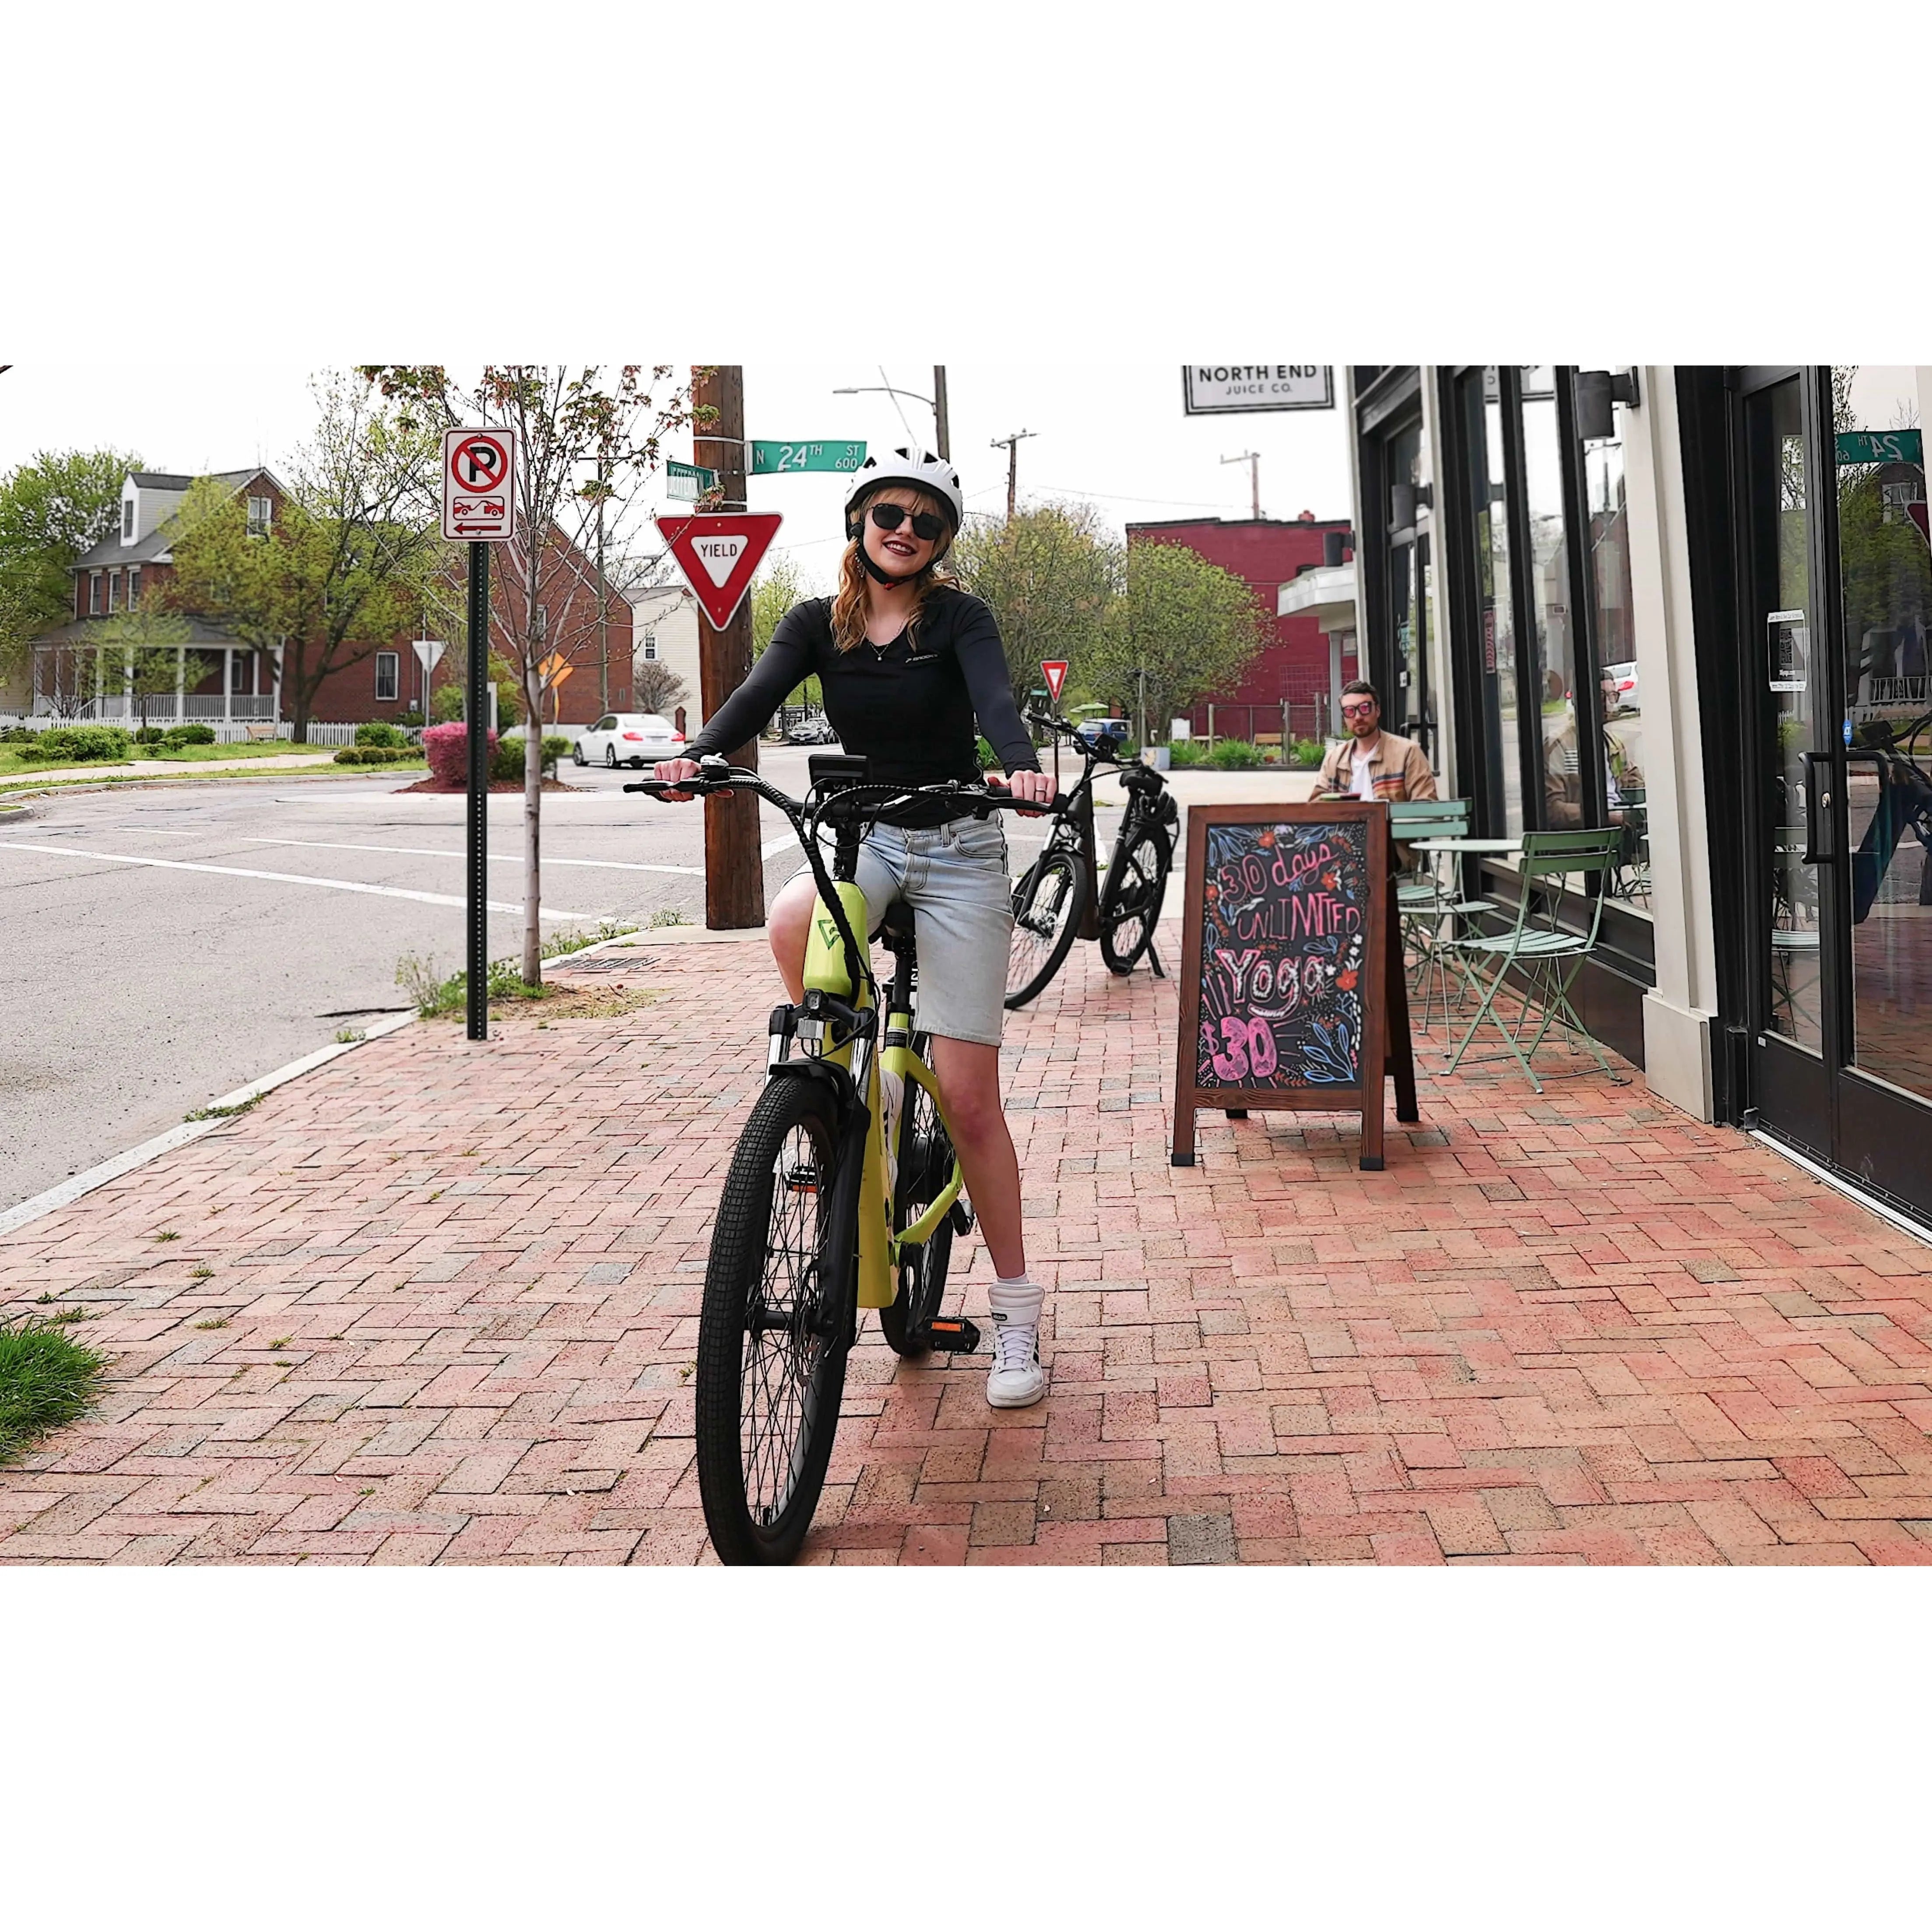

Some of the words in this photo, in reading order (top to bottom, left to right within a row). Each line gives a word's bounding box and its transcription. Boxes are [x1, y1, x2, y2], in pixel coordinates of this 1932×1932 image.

[1199, 365, 1268, 382] NORTH
[1277, 365, 1317, 379] END
[1226, 384, 1264, 395] JUICE
[1271, 383, 1293, 393] CO.
[756, 450, 764, 465] N
[846, 445, 859, 456] ST
[835, 458, 857, 469] 600
[701, 544, 737, 557] YIELD
[1221, 854, 1268, 903] 30
[1271, 843, 1339, 886] days
[1237, 892, 1361, 941] UNLIMITED
[1215, 948, 1325, 1020] Yoga
[1201, 1016, 1278, 1081] $30
